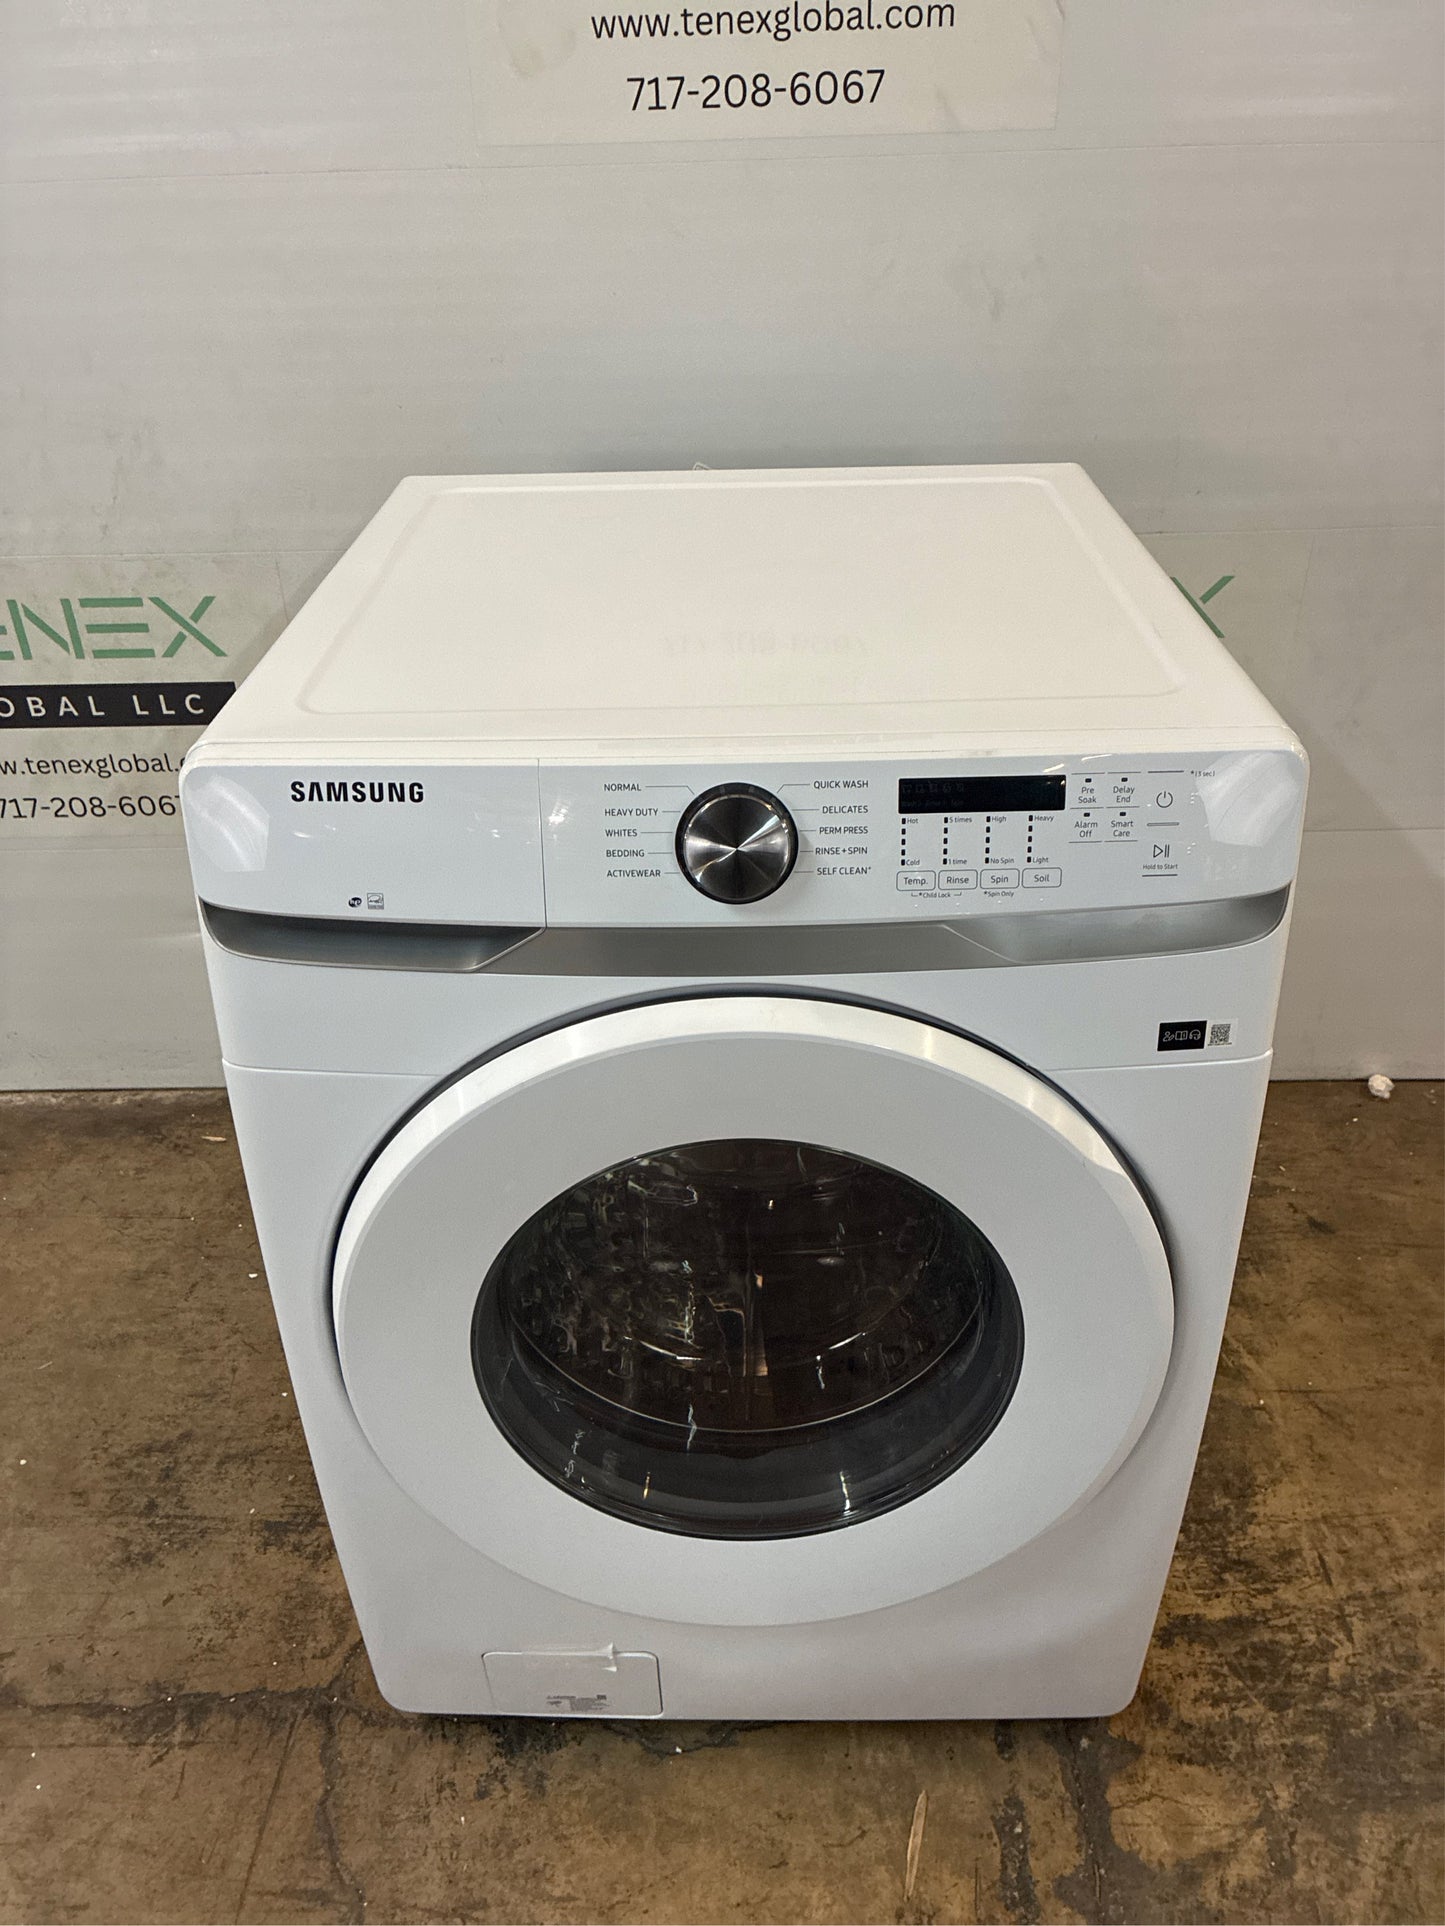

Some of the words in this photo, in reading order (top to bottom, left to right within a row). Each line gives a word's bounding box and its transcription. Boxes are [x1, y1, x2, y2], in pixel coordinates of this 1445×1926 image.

[591, 0, 955, 41] www.tenexglobal.com
[626, 69, 885, 111] 717-208-6067
[0, 596, 228, 660] NEX
[132, 693, 205, 716] LLC
[0, 752, 186, 779] w.tenexglobal.
[603, 782, 642, 793] NORMAL
[812, 779, 842, 790] QUICK
[844, 779, 869, 789] WASH
[290, 781, 424, 803] SAMSUNG
[1081, 786, 1095, 795] Pre
[1112, 785, 1136, 796] Delay
[1077, 795, 1097, 805] Soak
[1115, 795, 1132, 804] End
[0, 795, 180, 819] 717-208-606
[604, 808, 634, 817] HEAVY
[634, 807, 659, 817] DUTY
[821, 804, 870, 815] DELICATES
[955, 814, 973, 824] times
[992, 815, 1007, 824] High
[1034, 814, 1055, 823] Heavy
[1074, 820, 1099, 829] Alarm
[1110, 819, 1135, 829] Smart
[605, 828, 638, 838] WHITES
[818, 826, 841, 836] PERM
[842, 825, 869, 835] PRESS
[1079, 830, 1093, 839] Off
[1113, 830, 1131, 838] Care
[605, 848, 645, 859] BEDDING
[814, 845, 841, 856] RINSE
[847, 845, 868, 855] SPIN
[906, 858, 921, 867] Cold
[952, 857, 968, 866] time
[990, 857, 1000, 865] No
[1001, 856, 1015, 866] Spin
[1032, 855, 1049, 865] Light
[816, 866, 838, 876] SELF
[1142, 863, 1156, 871] Hold
[1156, 863, 1164, 871] to
[1164, 863, 1179, 871] Start
[606, 868, 662, 879] ACTIVEWEAR
[1033, 873, 1050, 883] Soil
[904, 877, 928, 886] Temp.
[946, 875, 970, 884] Rinse
[990, 874, 1009, 886] Spin
[937, 890, 951, 898] Lock
[1000, 889, 1015, 897] Only
